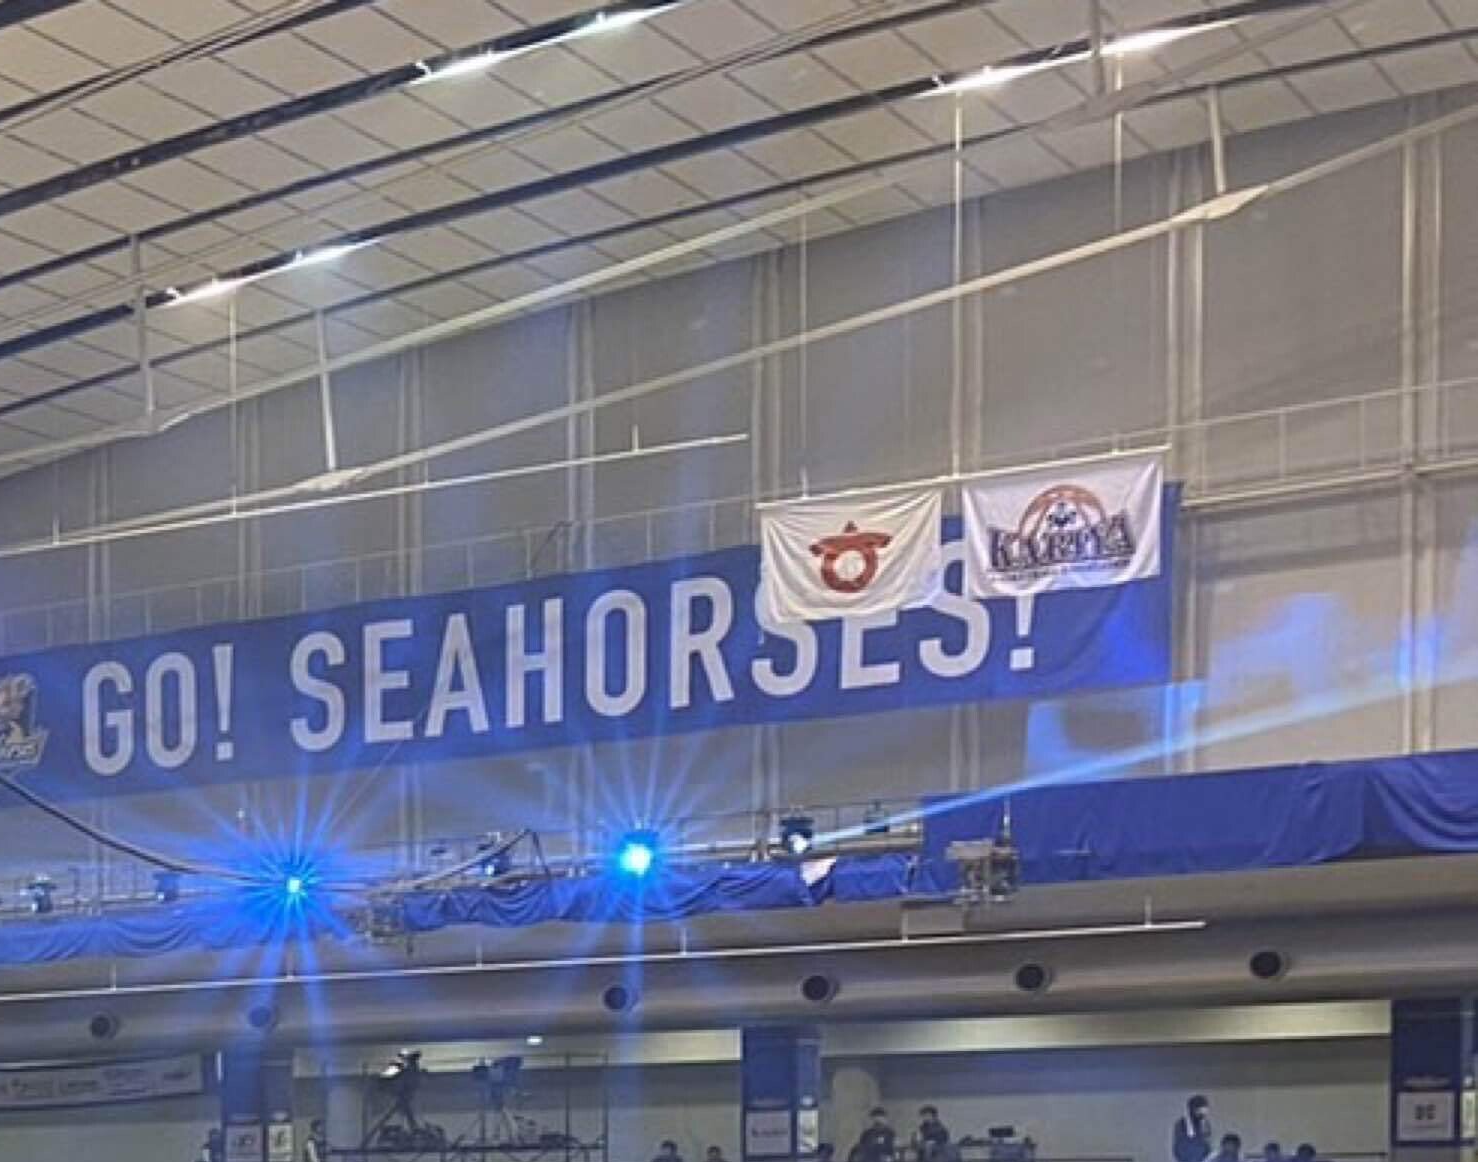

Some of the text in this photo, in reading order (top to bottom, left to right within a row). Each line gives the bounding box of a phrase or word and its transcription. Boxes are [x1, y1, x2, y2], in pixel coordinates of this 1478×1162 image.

[987, 511, 1135, 573] KARIYA
[81, 538, 1037, 778] GO! SEAHORSES!
